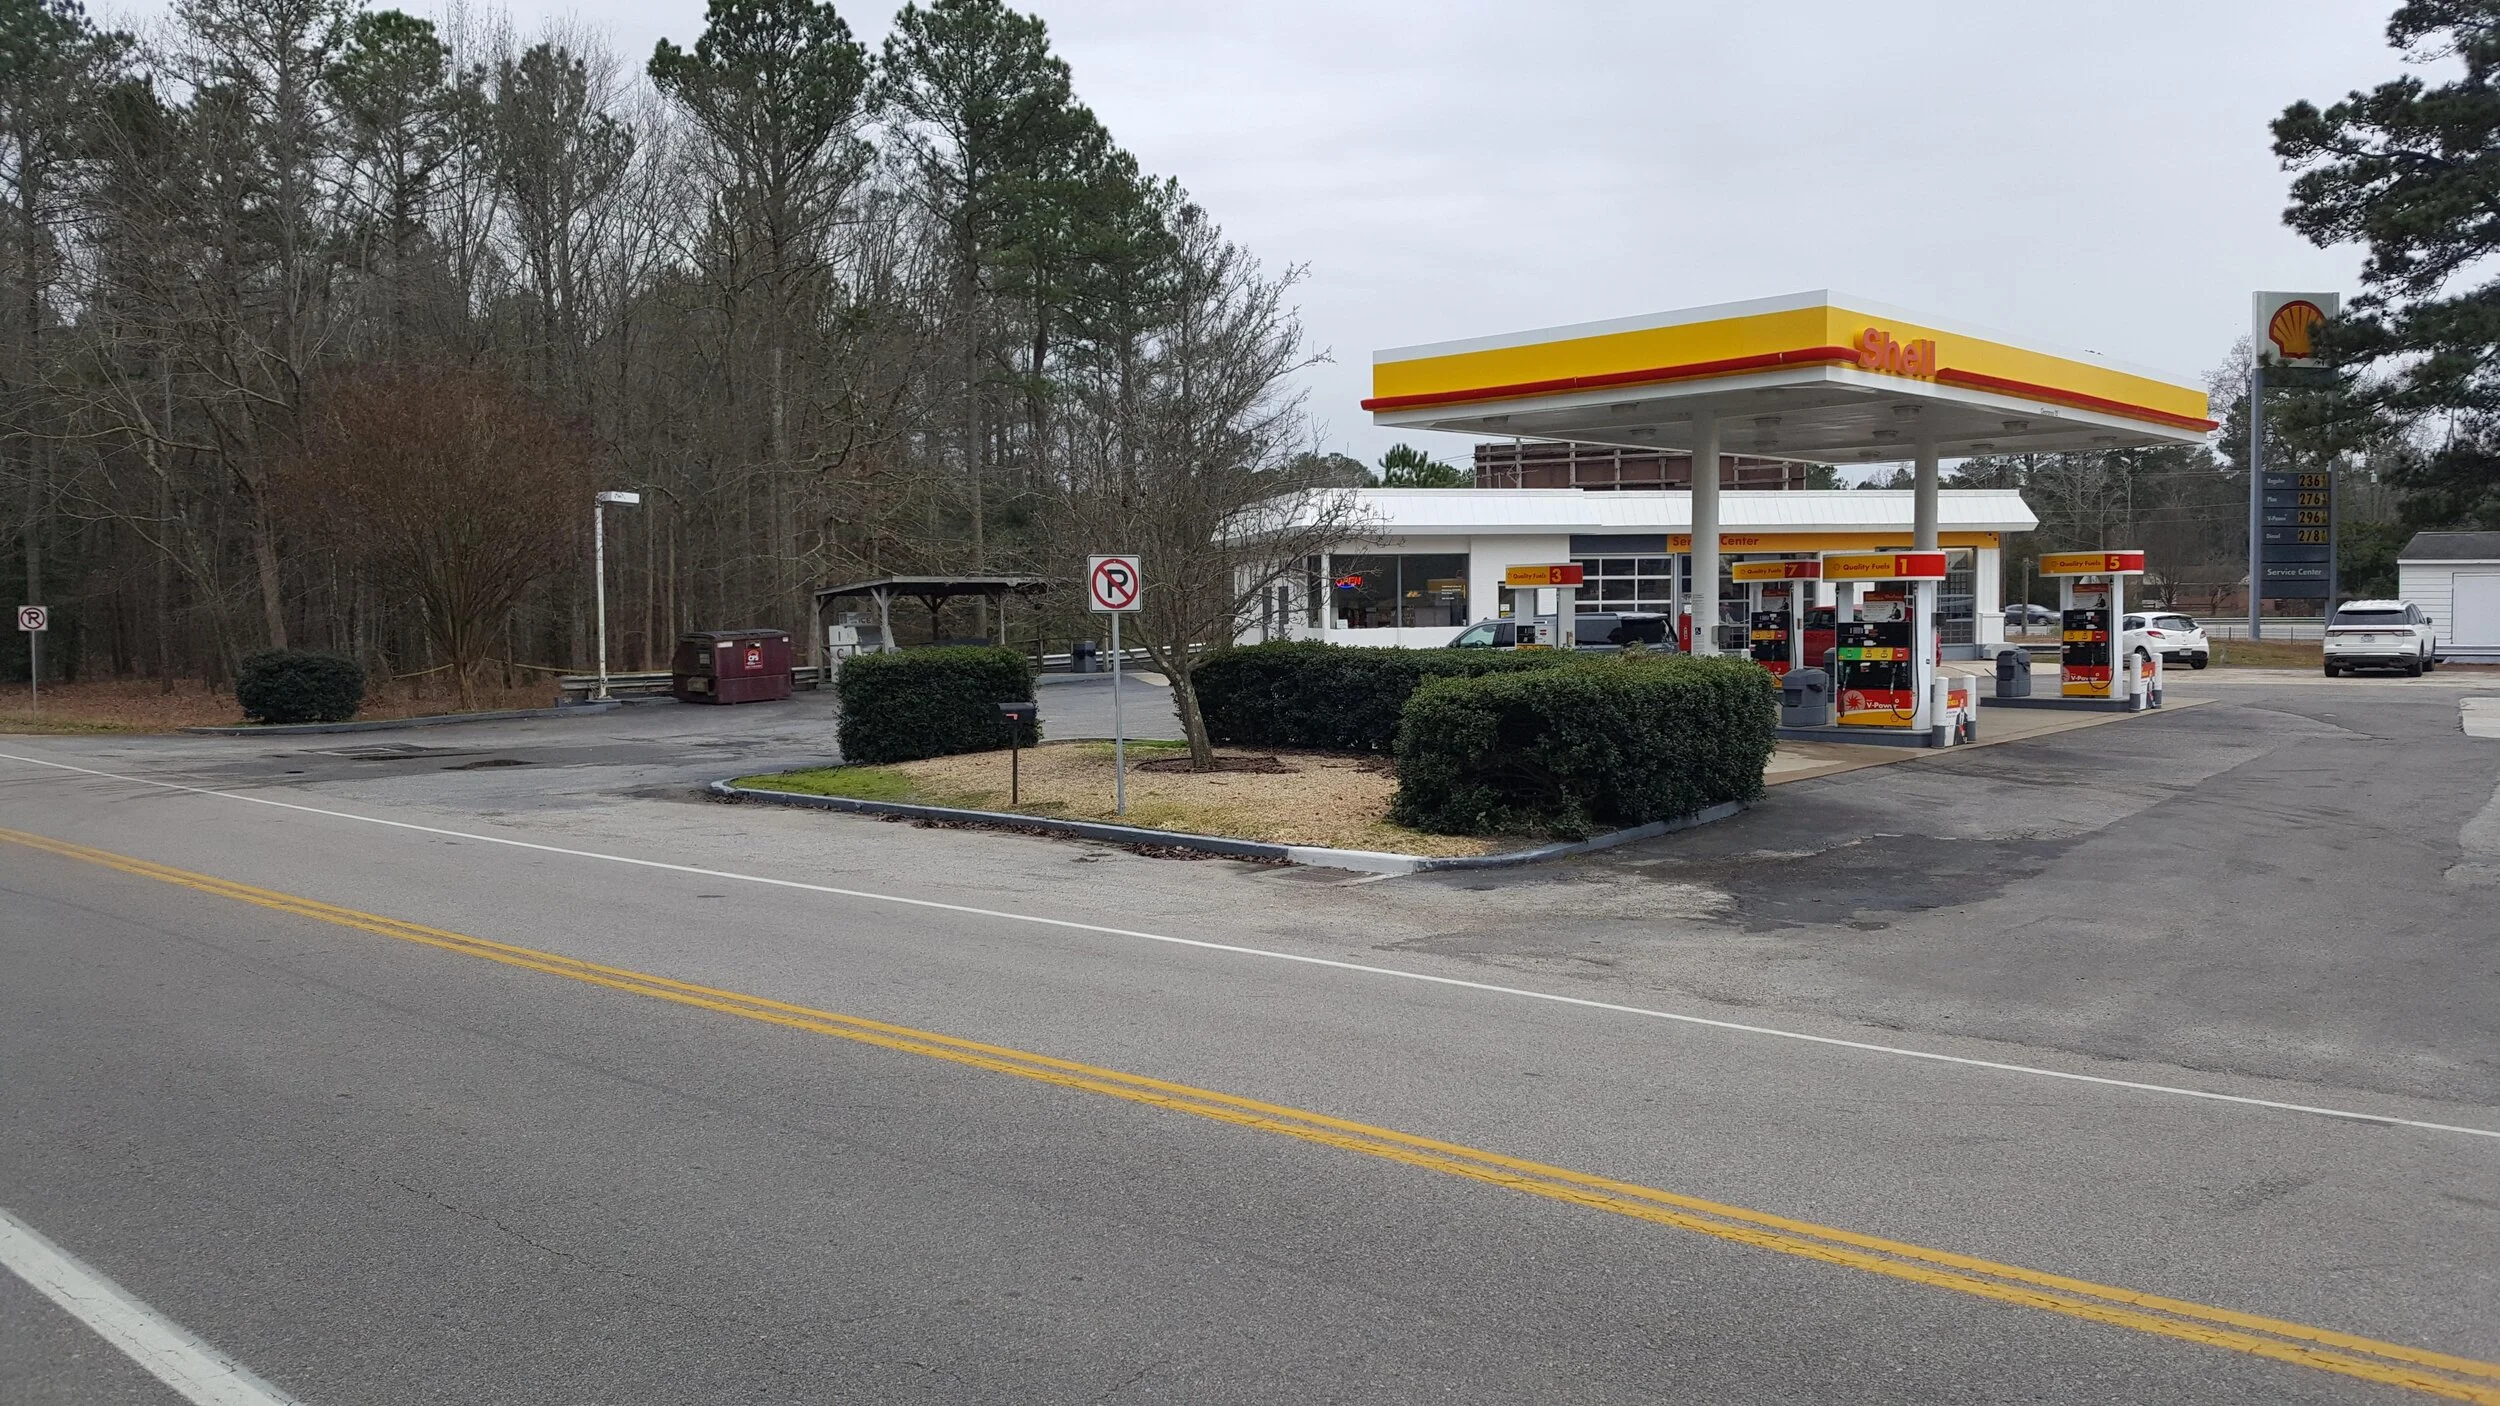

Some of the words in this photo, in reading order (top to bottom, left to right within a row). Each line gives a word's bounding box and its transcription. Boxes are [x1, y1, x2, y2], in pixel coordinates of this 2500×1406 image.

[1858, 327, 1936, 376] Shell
[2299, 475, 2320, 487] 236
[2299, 493, 2320, 505] 276
[2299, 511, 2320, 524] 296
[1720, 536, 1760, 546] Center
[1843, 563, 1870, 571] Quality
[1872, 562, 1890, 570] Fuels
[1900, 558, 1908, 574] 1
[2109, 556, 2120, 570] 5
[1551, 568, 1562, 583] 3
[2267, 568, 2297, 576] Service
[2298, 568, 2322, 576] Center
